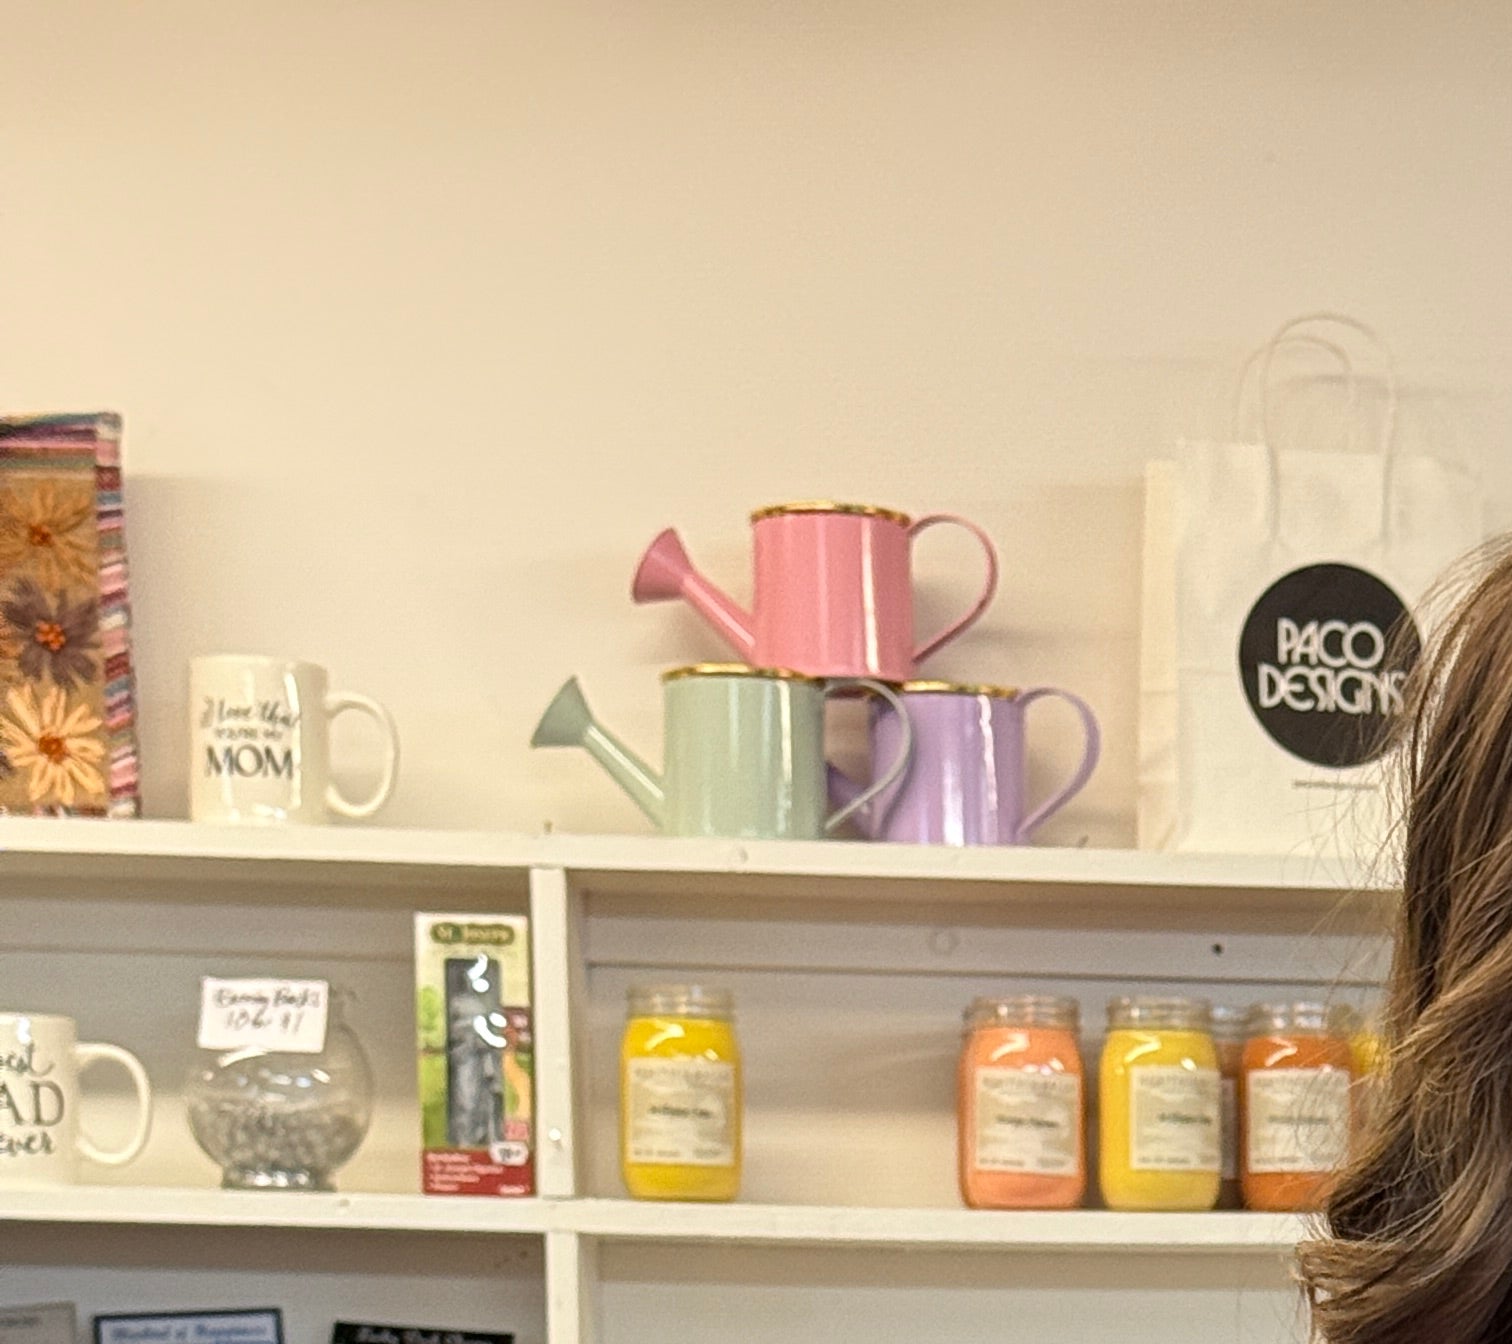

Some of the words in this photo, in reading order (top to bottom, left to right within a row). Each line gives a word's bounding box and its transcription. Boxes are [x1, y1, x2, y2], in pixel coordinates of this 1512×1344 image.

[1276, 616, 1385, 670] PACO
[1257, 662, 1407, 715] DESIGNS
[204, 743, 293, 781] MOM
[0, 1043, 55, 1077] est
[0, 1080, 65, 1127] AD
[0, 1131, 54, 1157] ver
